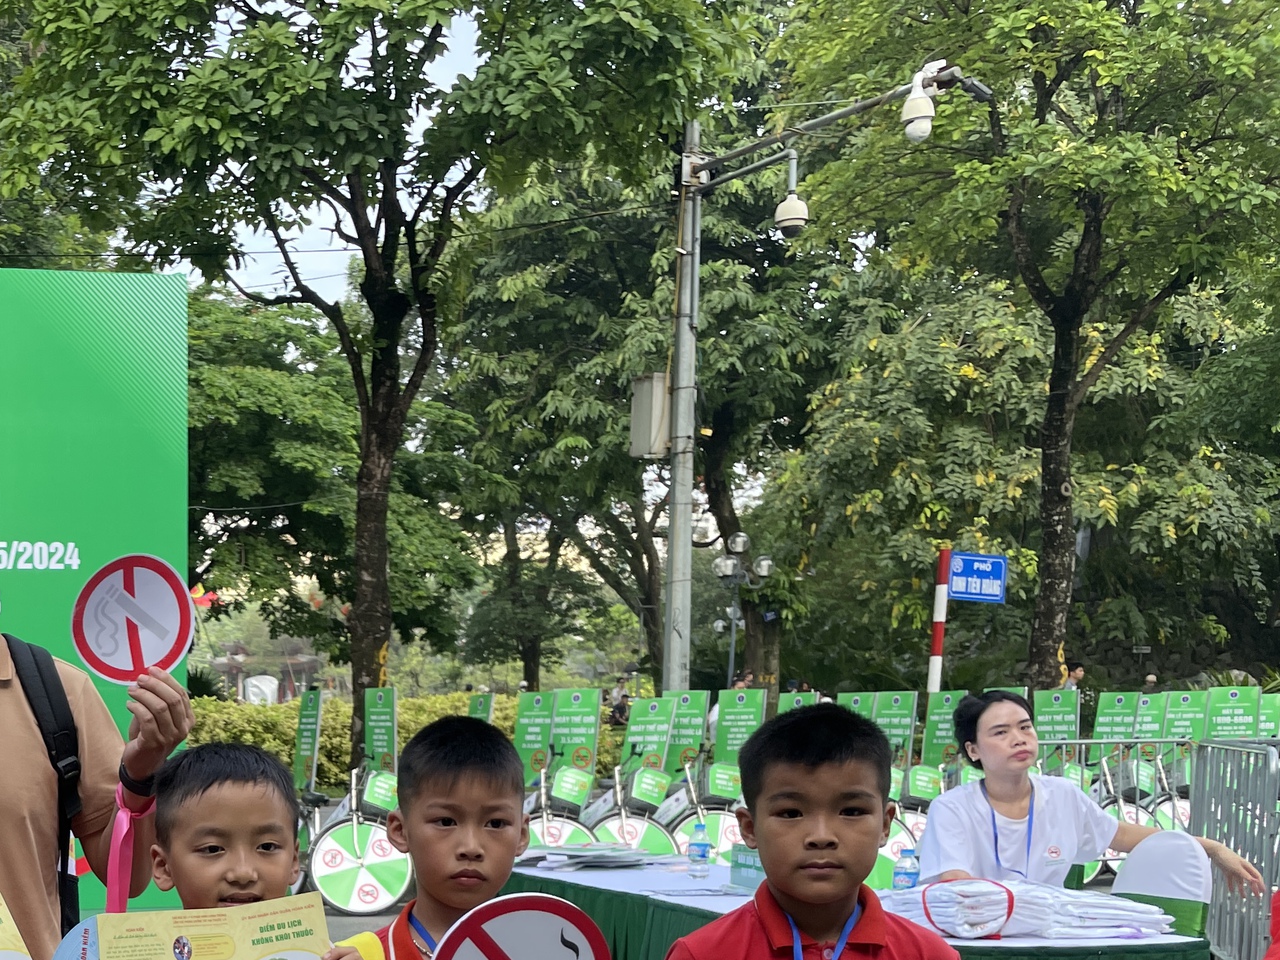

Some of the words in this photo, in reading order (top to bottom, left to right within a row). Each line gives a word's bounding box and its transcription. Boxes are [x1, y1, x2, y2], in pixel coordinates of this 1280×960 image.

[973, 559, 992, 572] PHỐ
[251, 936, 274, 946] KHÔNG
[275, 931, 291, 942] KHÓI
[292, 928, 314, 939] THUỐC
